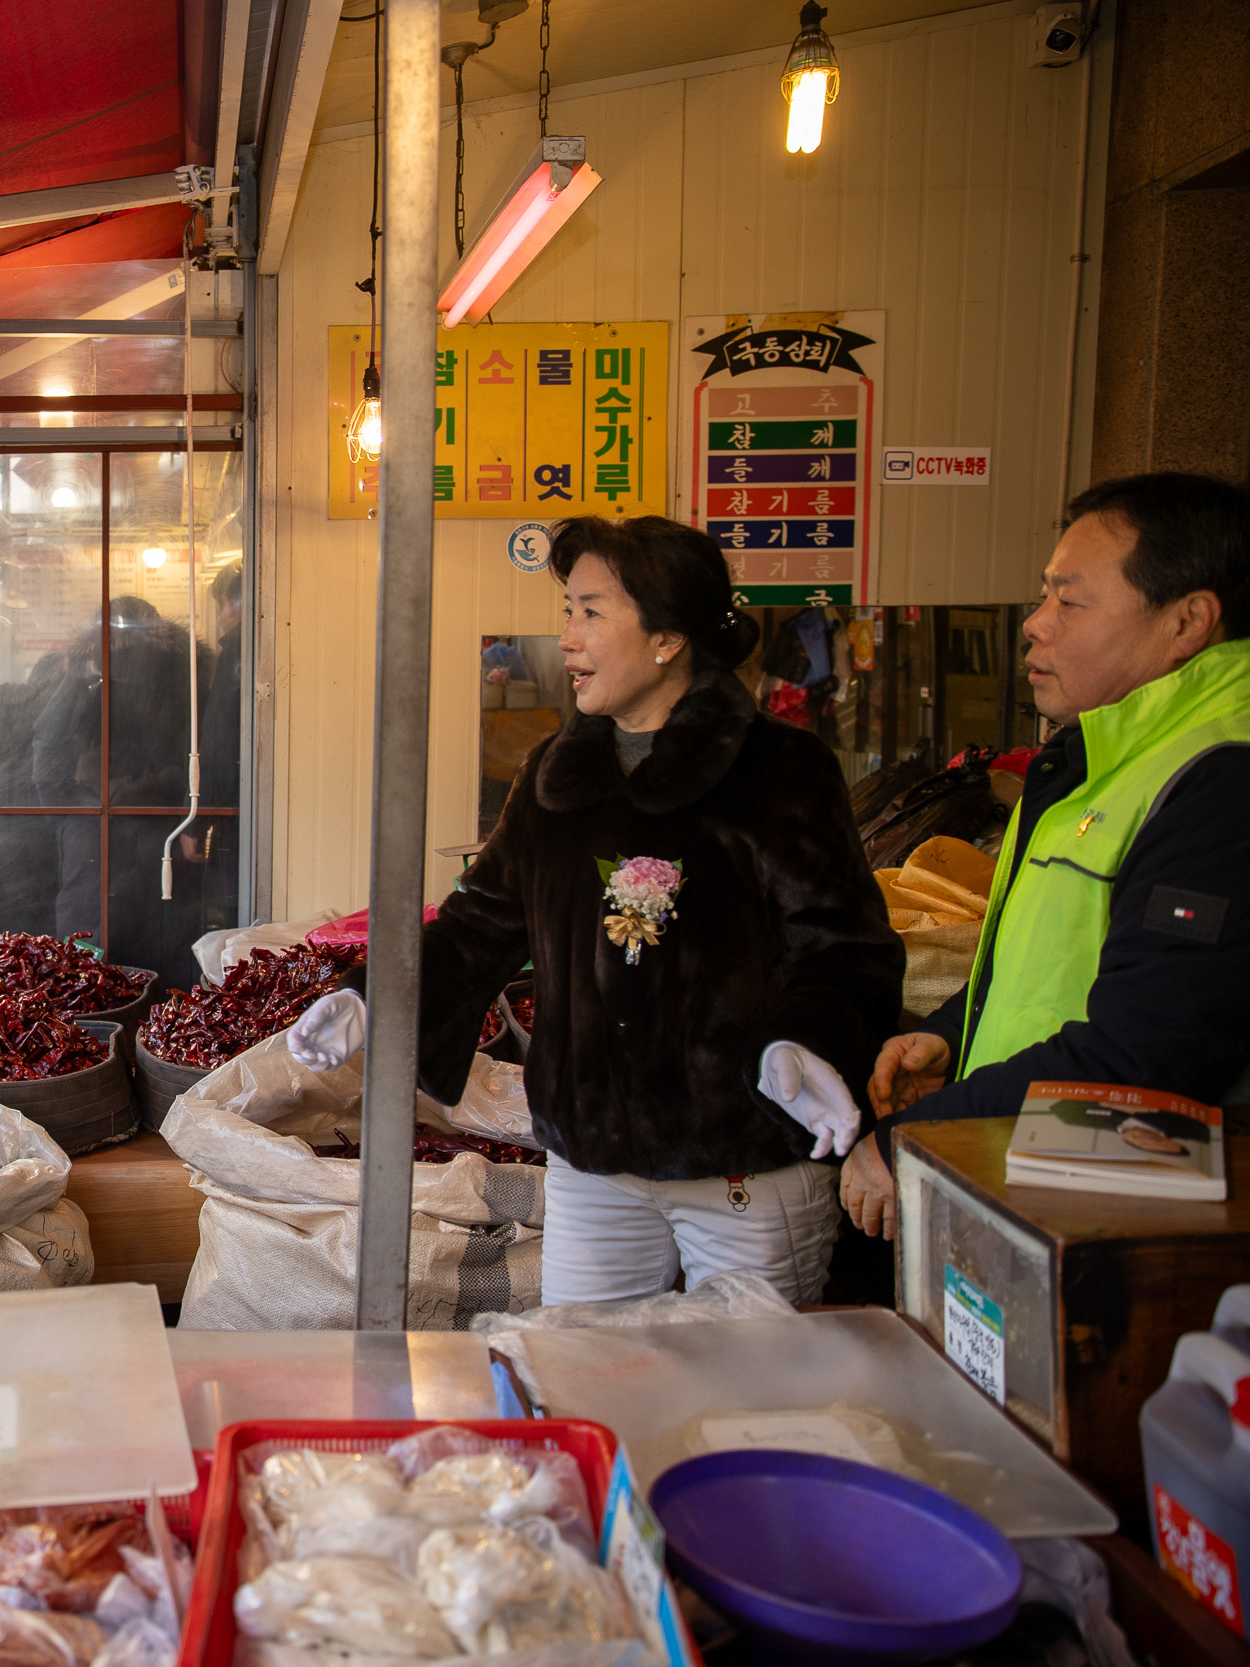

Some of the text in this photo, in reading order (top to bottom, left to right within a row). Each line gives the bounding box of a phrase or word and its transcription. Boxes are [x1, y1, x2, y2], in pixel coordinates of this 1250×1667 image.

[732, 334, 832, 368] 극동상회
[594, 348, 633, 501] 미수가루
[916, 457, 987, 476] CCTV녹화중
